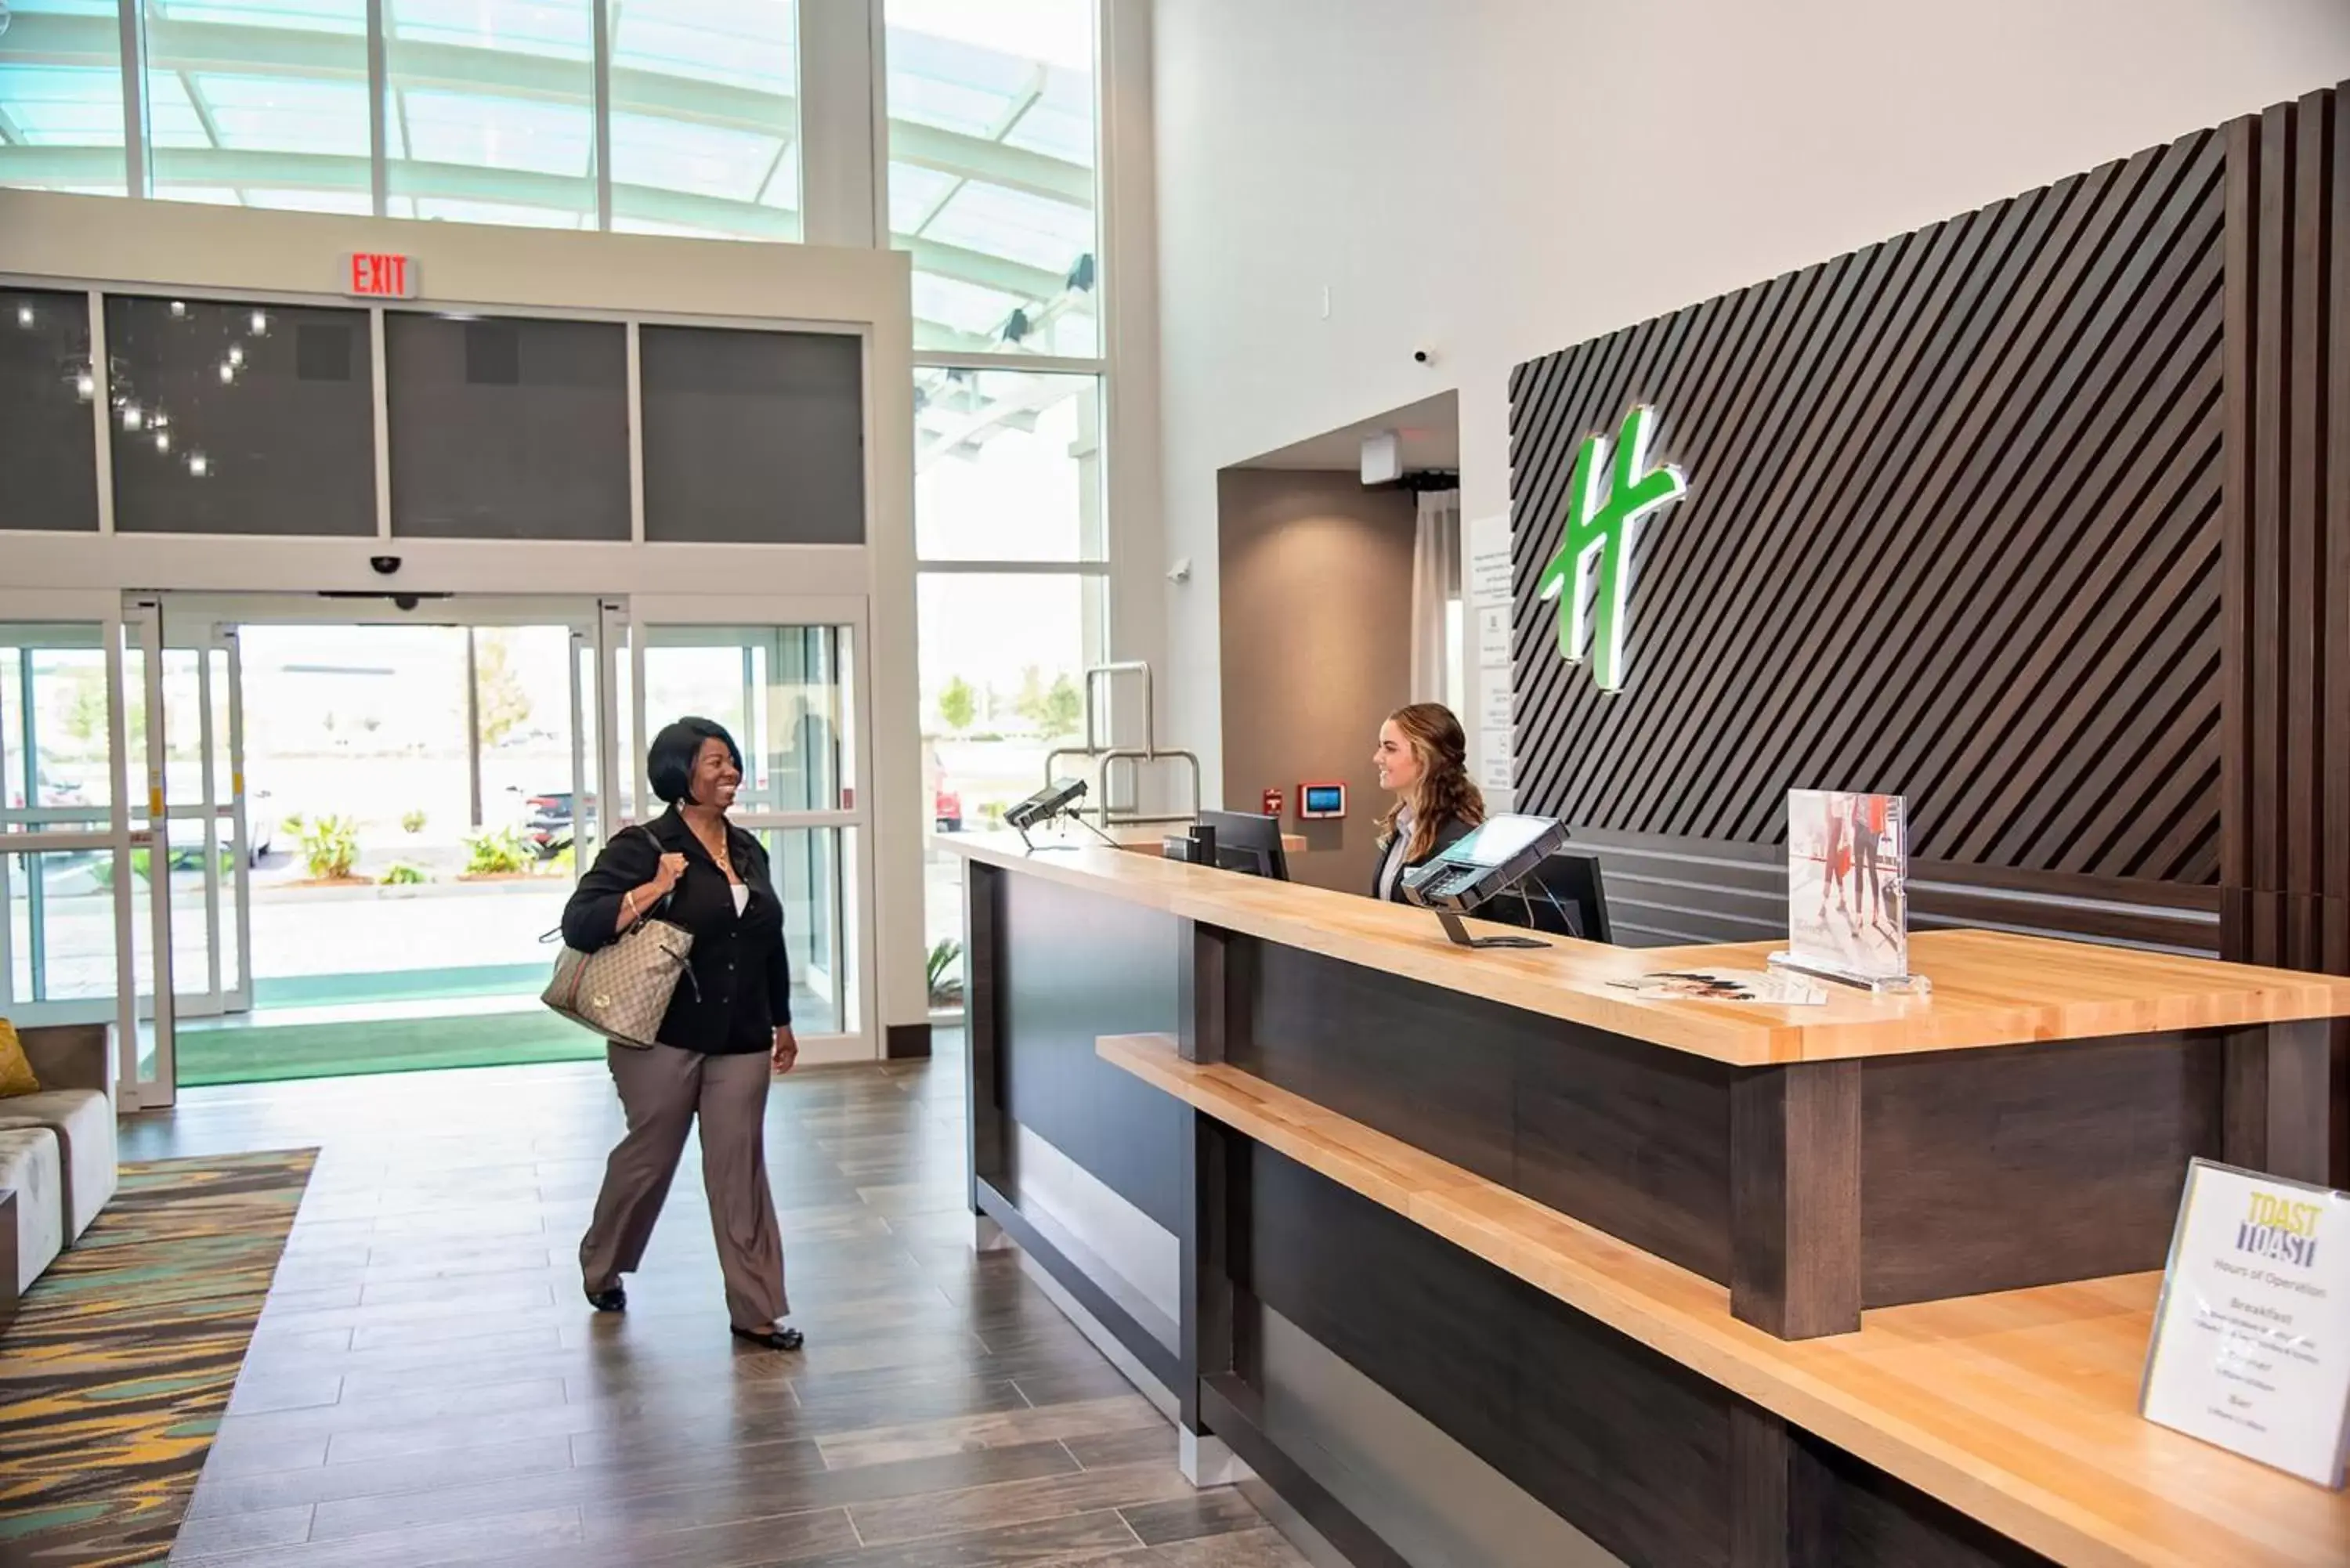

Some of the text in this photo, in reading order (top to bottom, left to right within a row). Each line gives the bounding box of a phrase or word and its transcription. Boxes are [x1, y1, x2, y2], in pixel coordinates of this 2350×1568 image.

[352, 254, 406, 295] EXIT
[1539, 404, 1687, 694] H
[2248, 1191, 2323, 1237] TOAST
[2214, 1259, 2327, 1298] Hours of Operation
[2231, 1297, 2293, 1324] Breakfast
